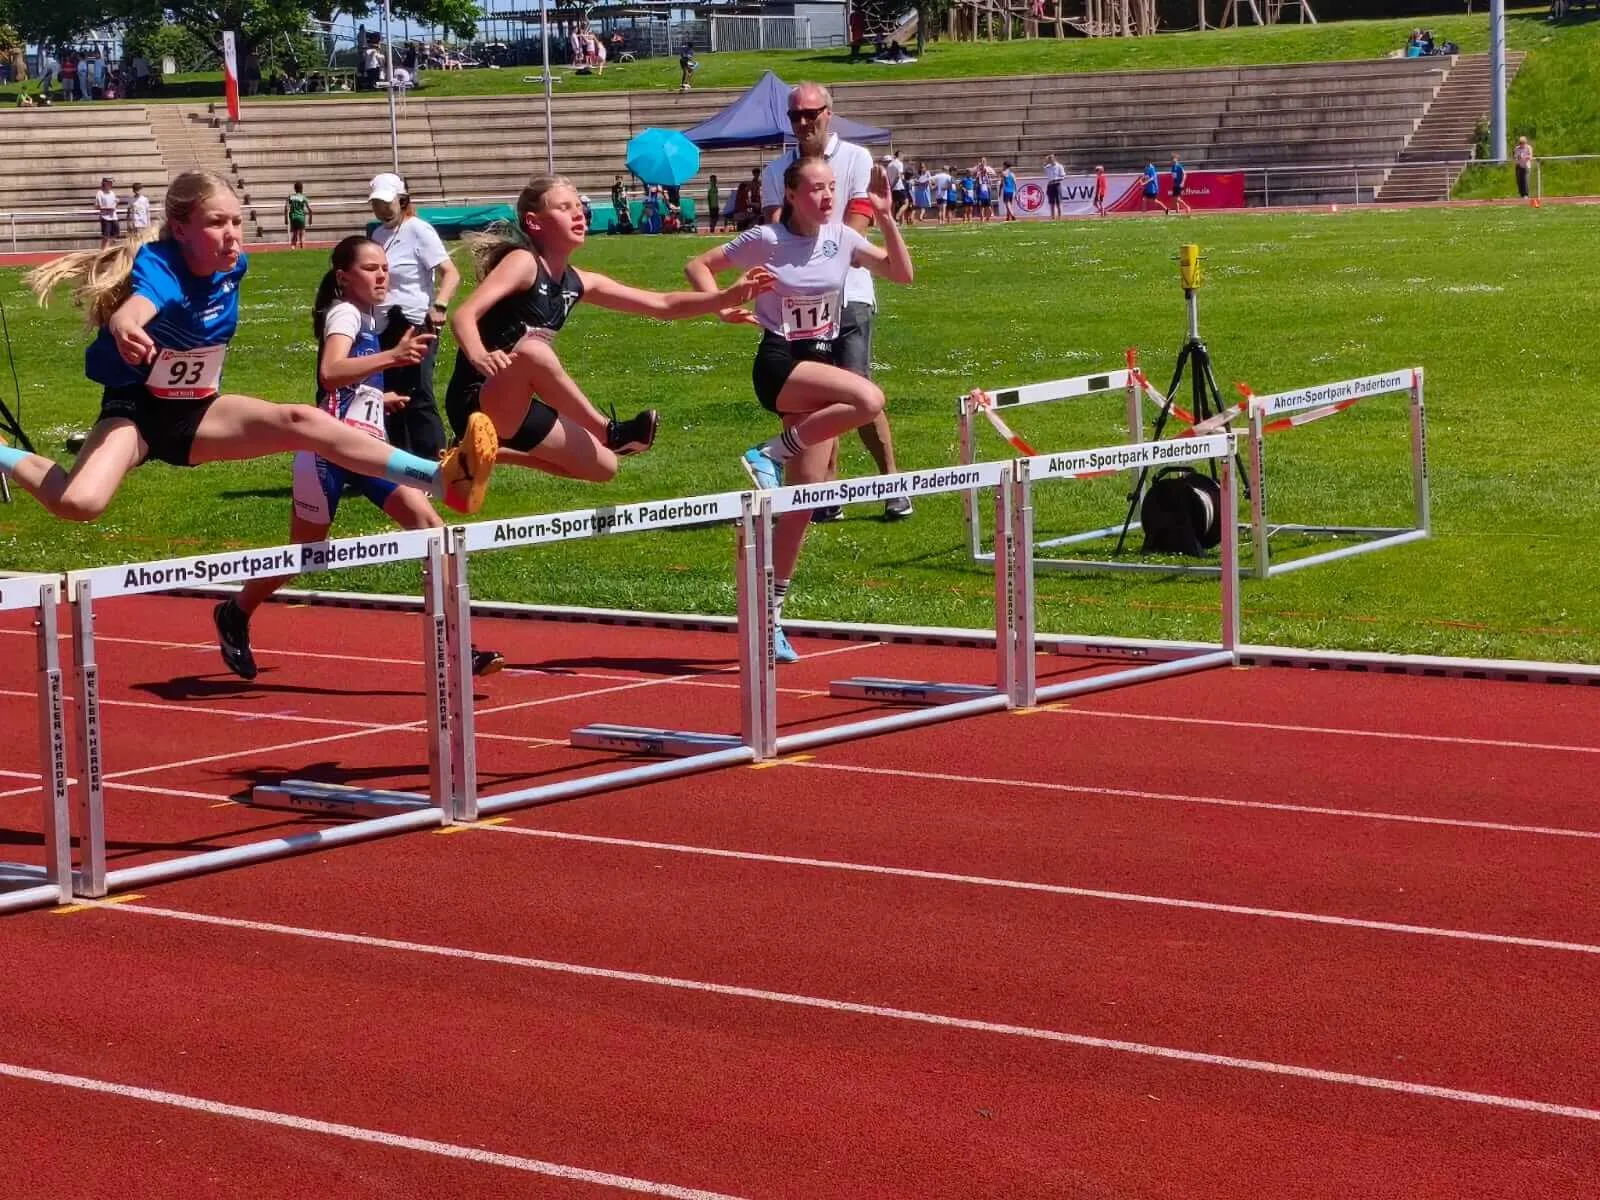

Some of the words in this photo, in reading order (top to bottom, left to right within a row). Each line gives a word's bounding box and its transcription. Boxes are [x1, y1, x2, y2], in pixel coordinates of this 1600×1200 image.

[792, 303, 830, 329] 114
[168, 361, 205, 385] 93
[1274, 385, 1352, 409] Ahorn-Sportpark
[1354, 376, 1401, 393] Paderborn
[1048, 448, 1148, 472] Ahorn-Sportpark
[1152, 442, 1210, 460] Paderborn
[792, 478, 908, 505] Ahorn-Sportpark
[912, 469, 980, 491] Paderborn
[493, 509, 634, 542] Ahorn-Sportpark
[639, 500, 719, 523] Paderborn
[123, 550, 295, 588] Ahorn-Sportpark
[301, 540, 399, 566] Paderborn
[86, 671, 97, 725] WELLER
[54, 743, 65, 799] HERDEN
[89, 738, 100, 793] HERDEN
